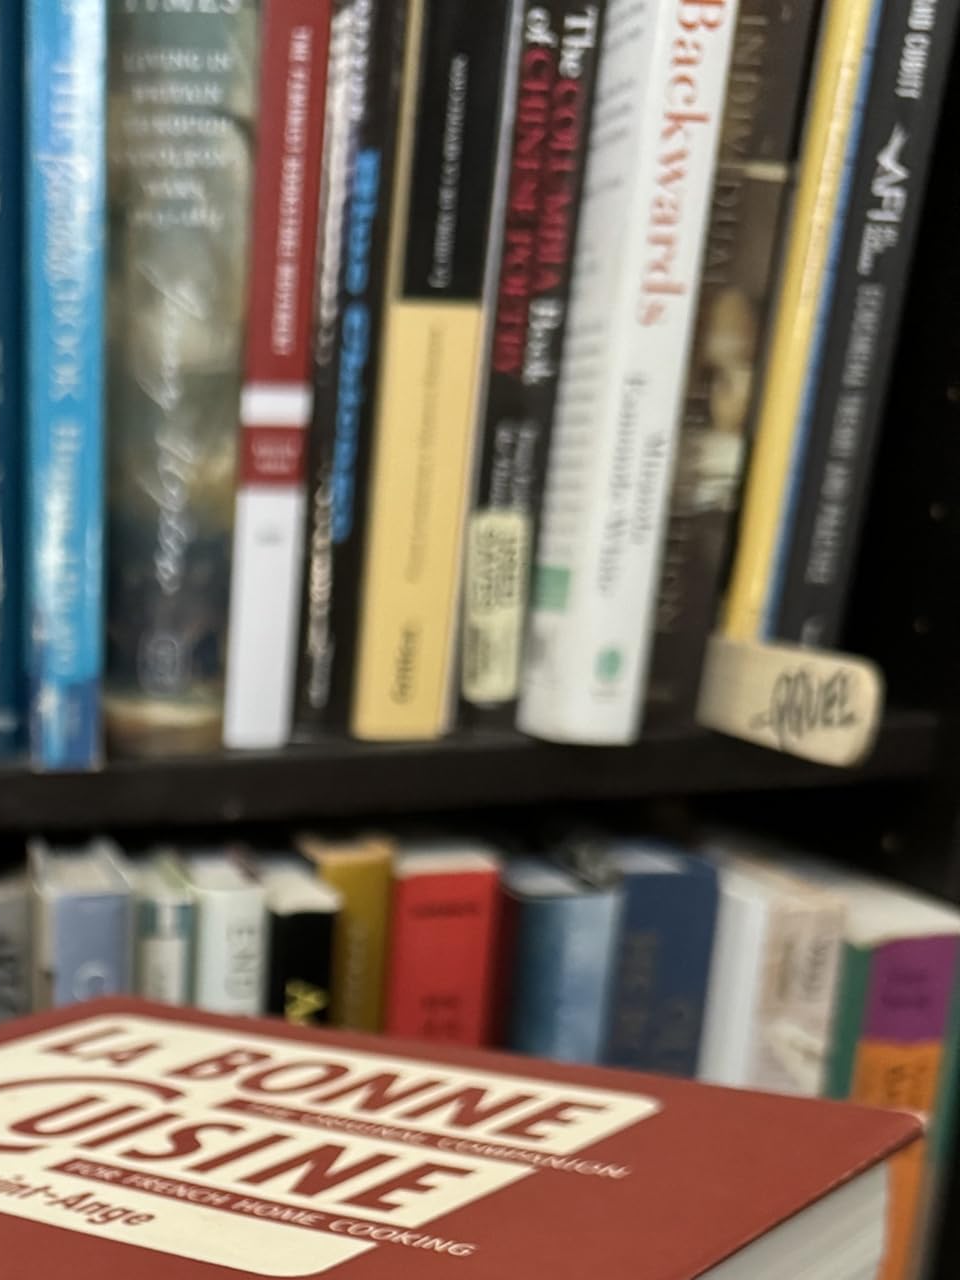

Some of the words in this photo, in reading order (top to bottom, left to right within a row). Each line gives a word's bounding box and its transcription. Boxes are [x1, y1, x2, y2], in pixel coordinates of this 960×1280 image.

[525, 6, 558, 48] of
[559, 8, 596, 78] The
[637, 0, 725, 328] Backwards
[524, 299, 564, 386] Book
[42, 1025, 163, 1066] LA
[166, 1049, 613, 1143] BONNE
[65, 1160, 120, 1182] FOR
[125, 1172, 234, 1208] FRENCH
[240, 1195, 321, 1229] HOME
[327, 1217, 478, 1258] COOKING
